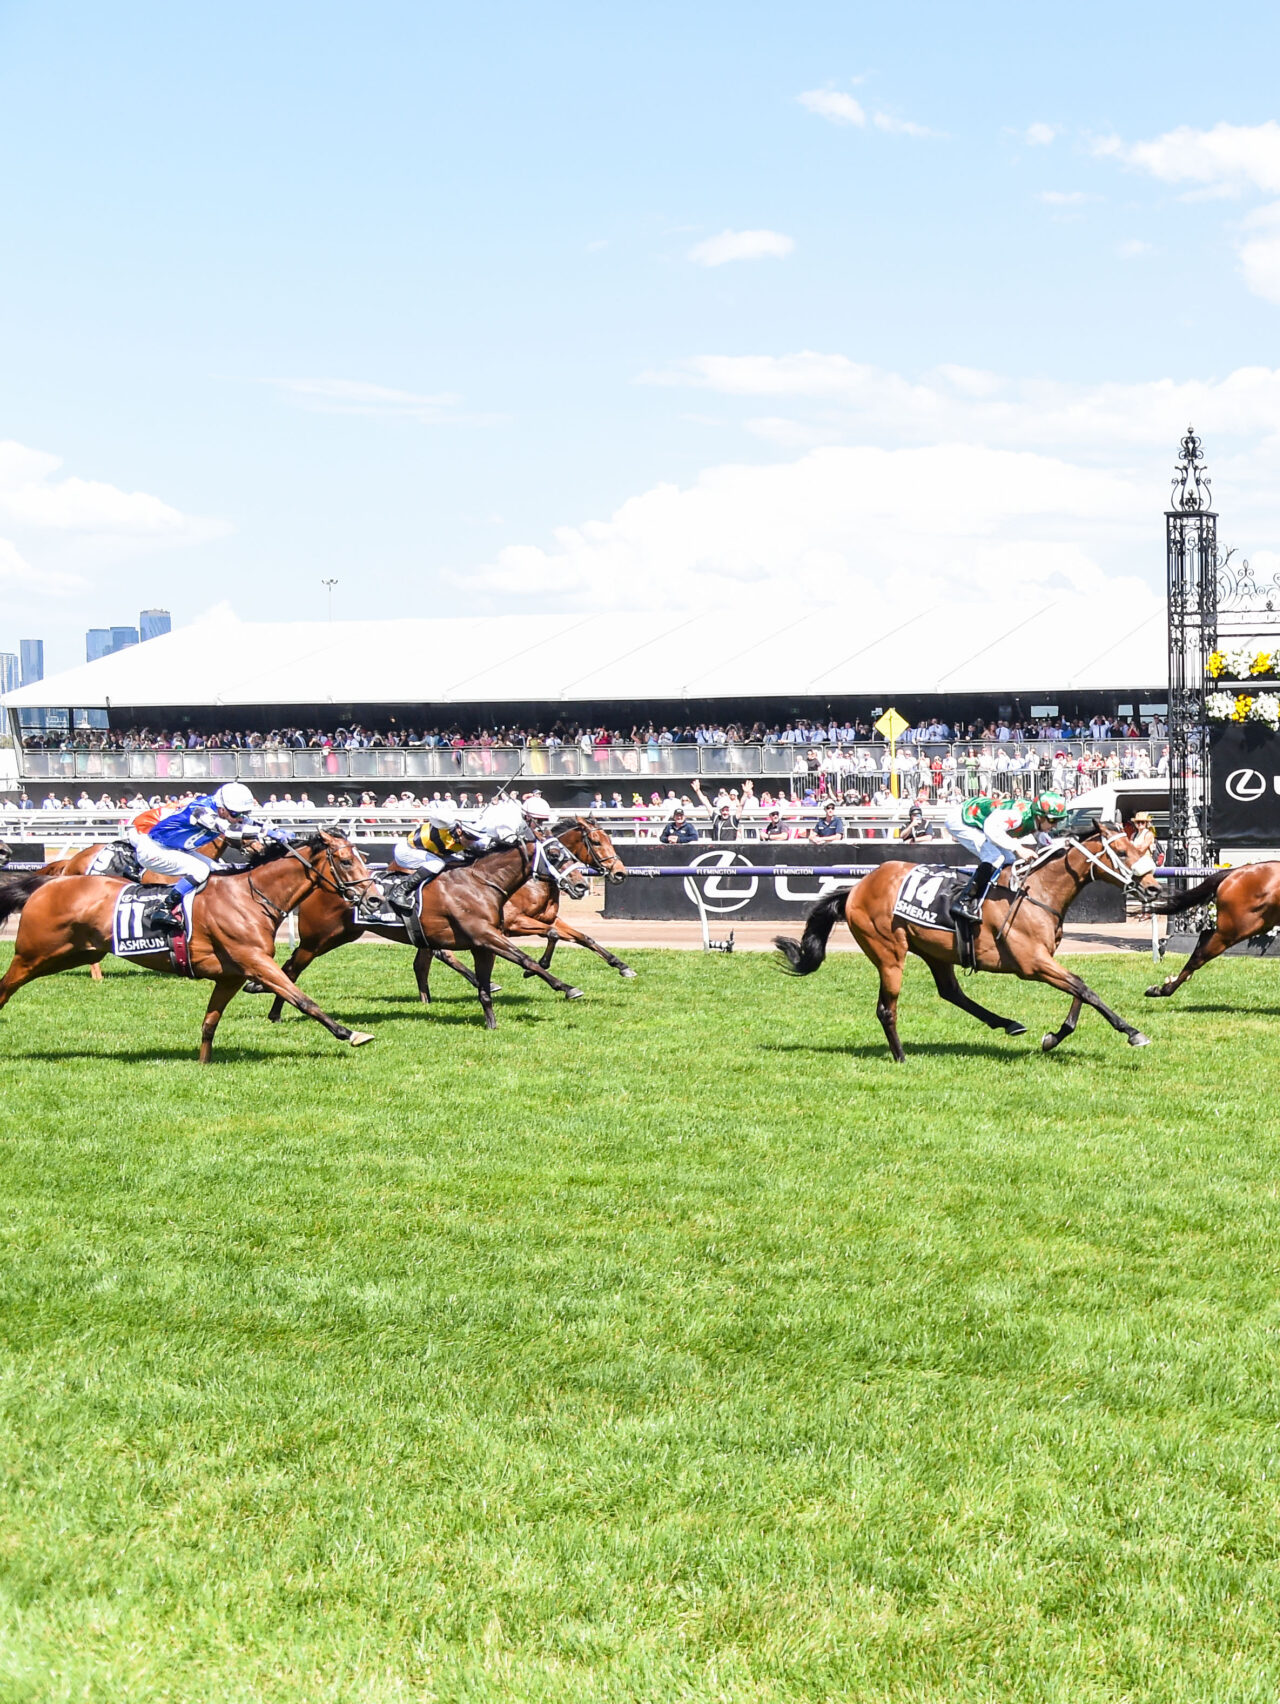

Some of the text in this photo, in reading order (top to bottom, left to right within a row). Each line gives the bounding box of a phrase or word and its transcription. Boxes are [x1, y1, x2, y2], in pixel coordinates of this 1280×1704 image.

[697, 868, 737, 876] FLEMINGTON
[773, 868, 814, 876] FLEMINGTON
[903, 871, 944, 909] 14
[118, 902, 146, 939] 11
[896, 900, 938, 924] SHERAZ
[119, 937, 165, 952] ASHRUN
